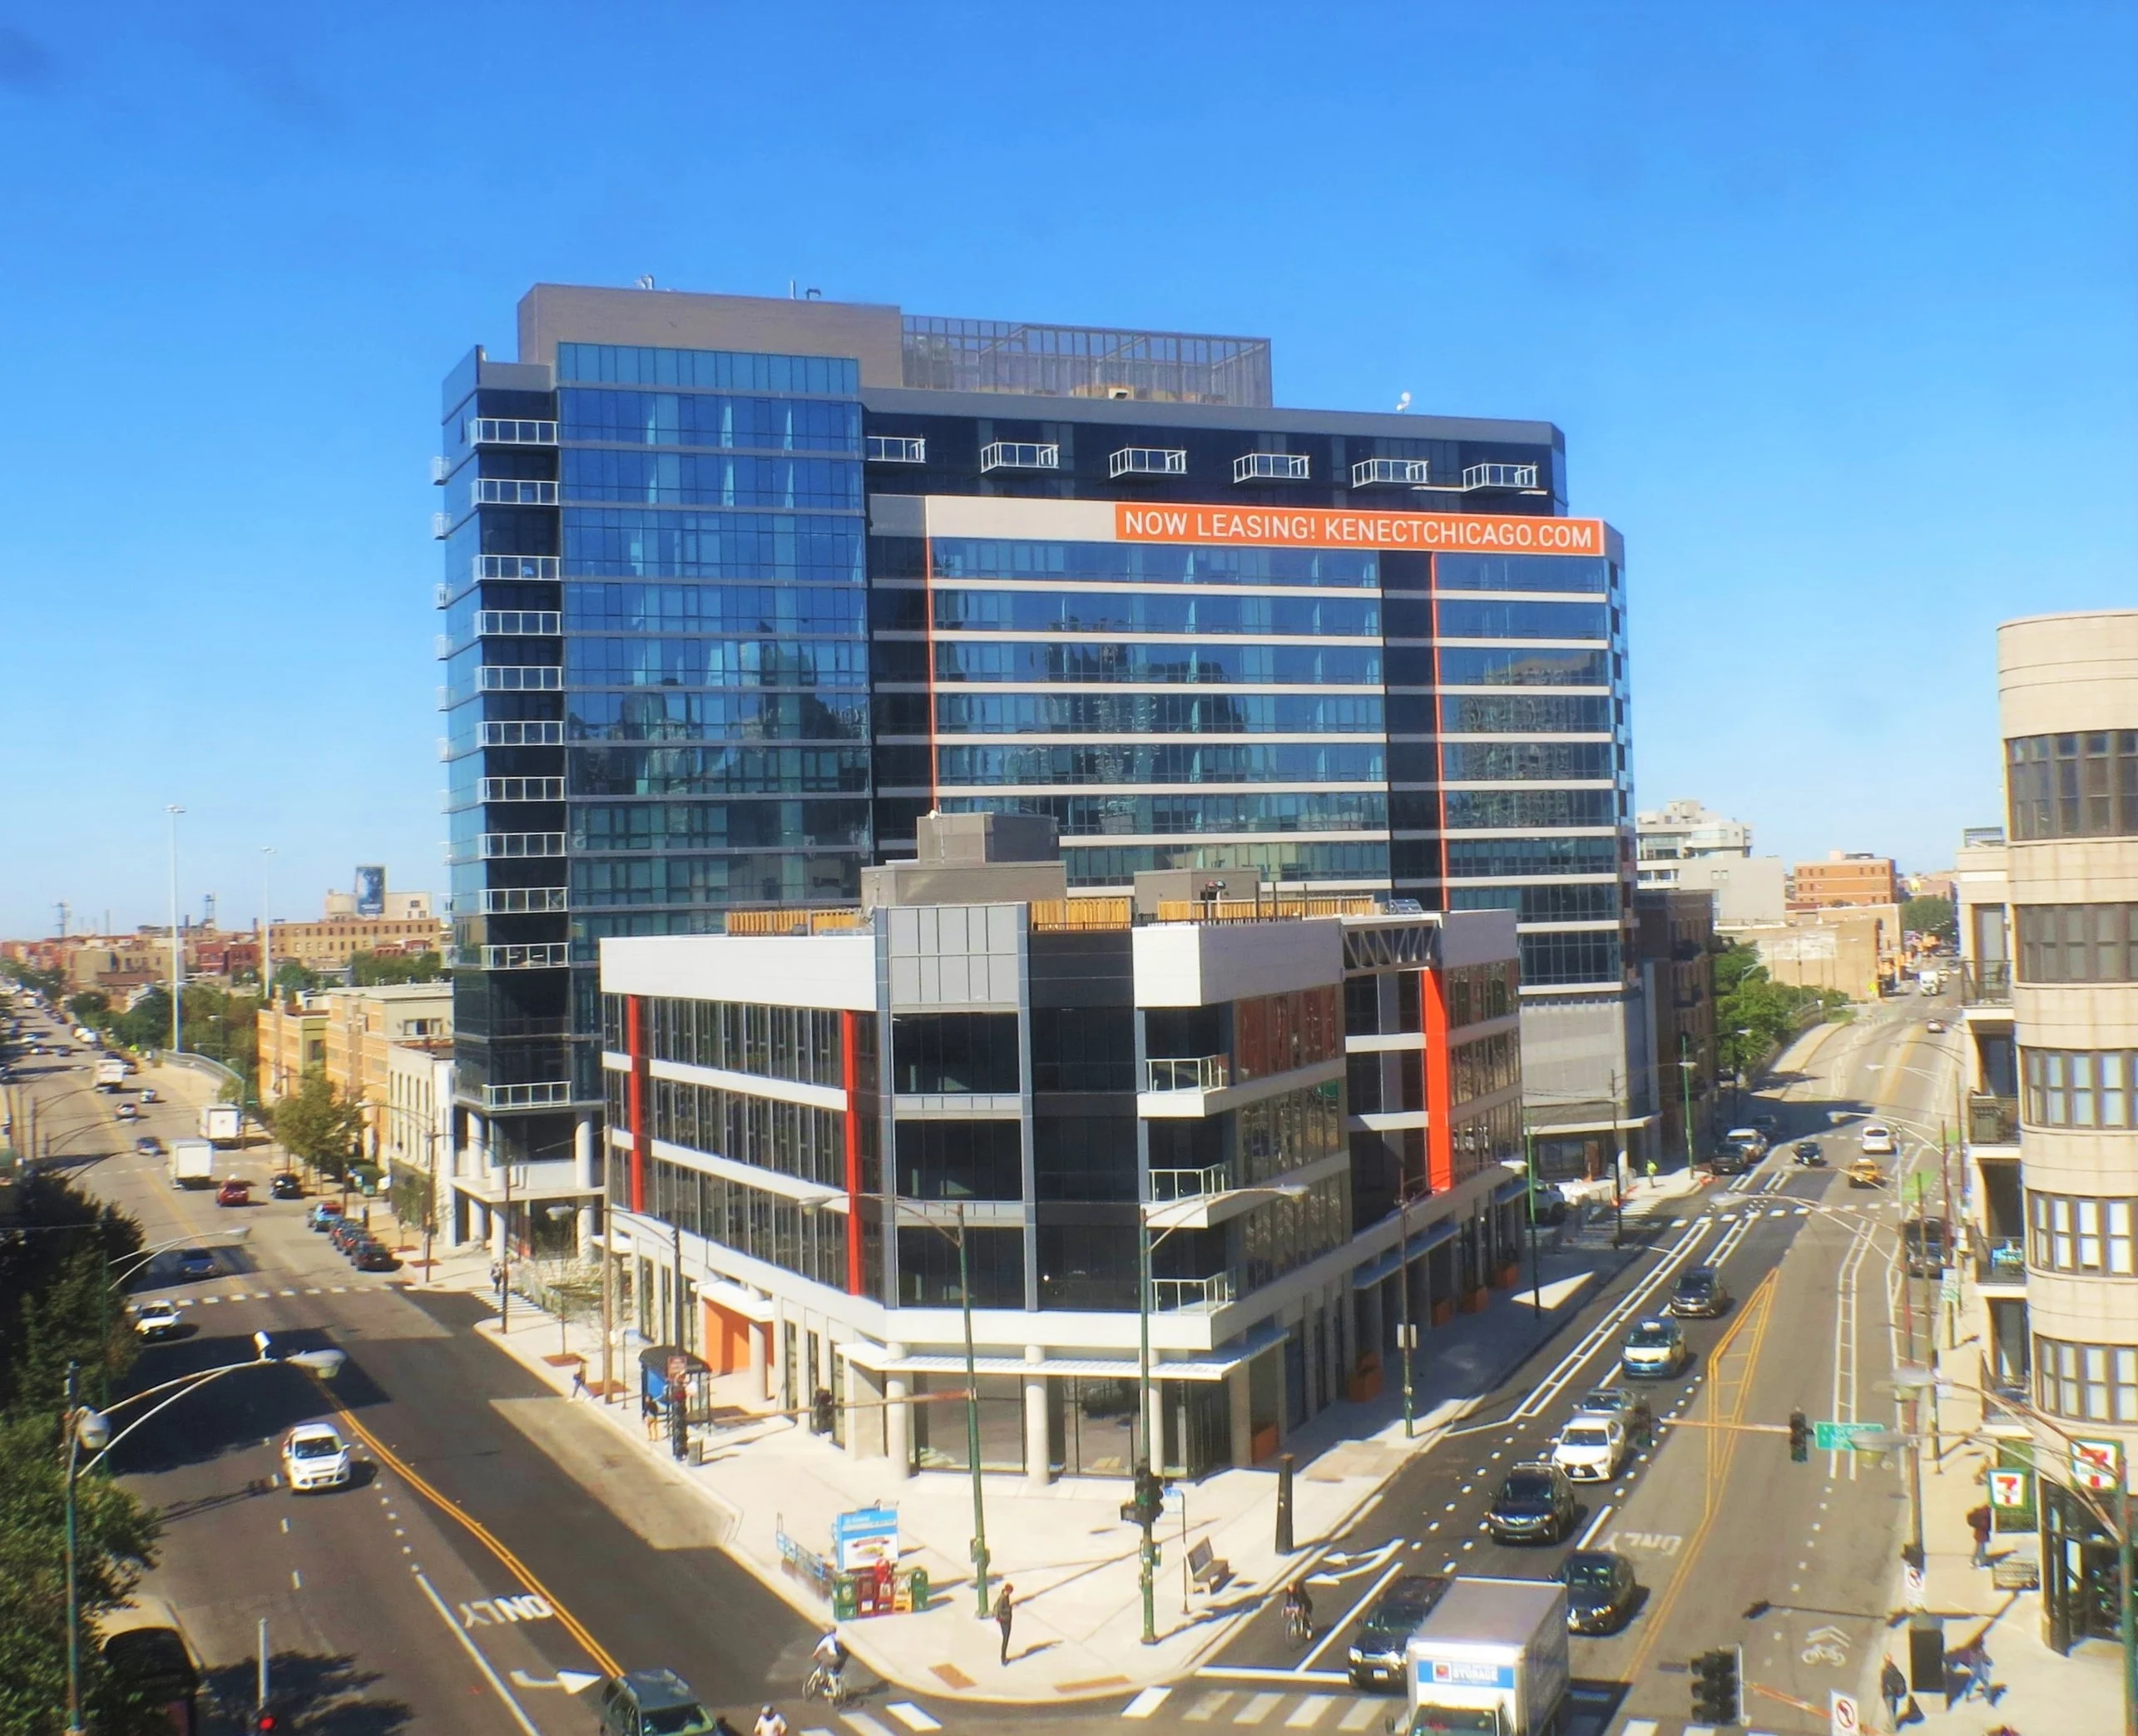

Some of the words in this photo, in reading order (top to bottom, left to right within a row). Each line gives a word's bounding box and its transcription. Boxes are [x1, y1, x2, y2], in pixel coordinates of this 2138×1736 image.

[1125, 510, 1187, 536] NOW
[1197, 513, 1316, 540] LEASING!
[1324, 518, 1592, 548] KENECTCHICAGO.COM
[1594, 1531, 1682, 1556] ONLY
[458, 1594, 553, 1628] ONLY
